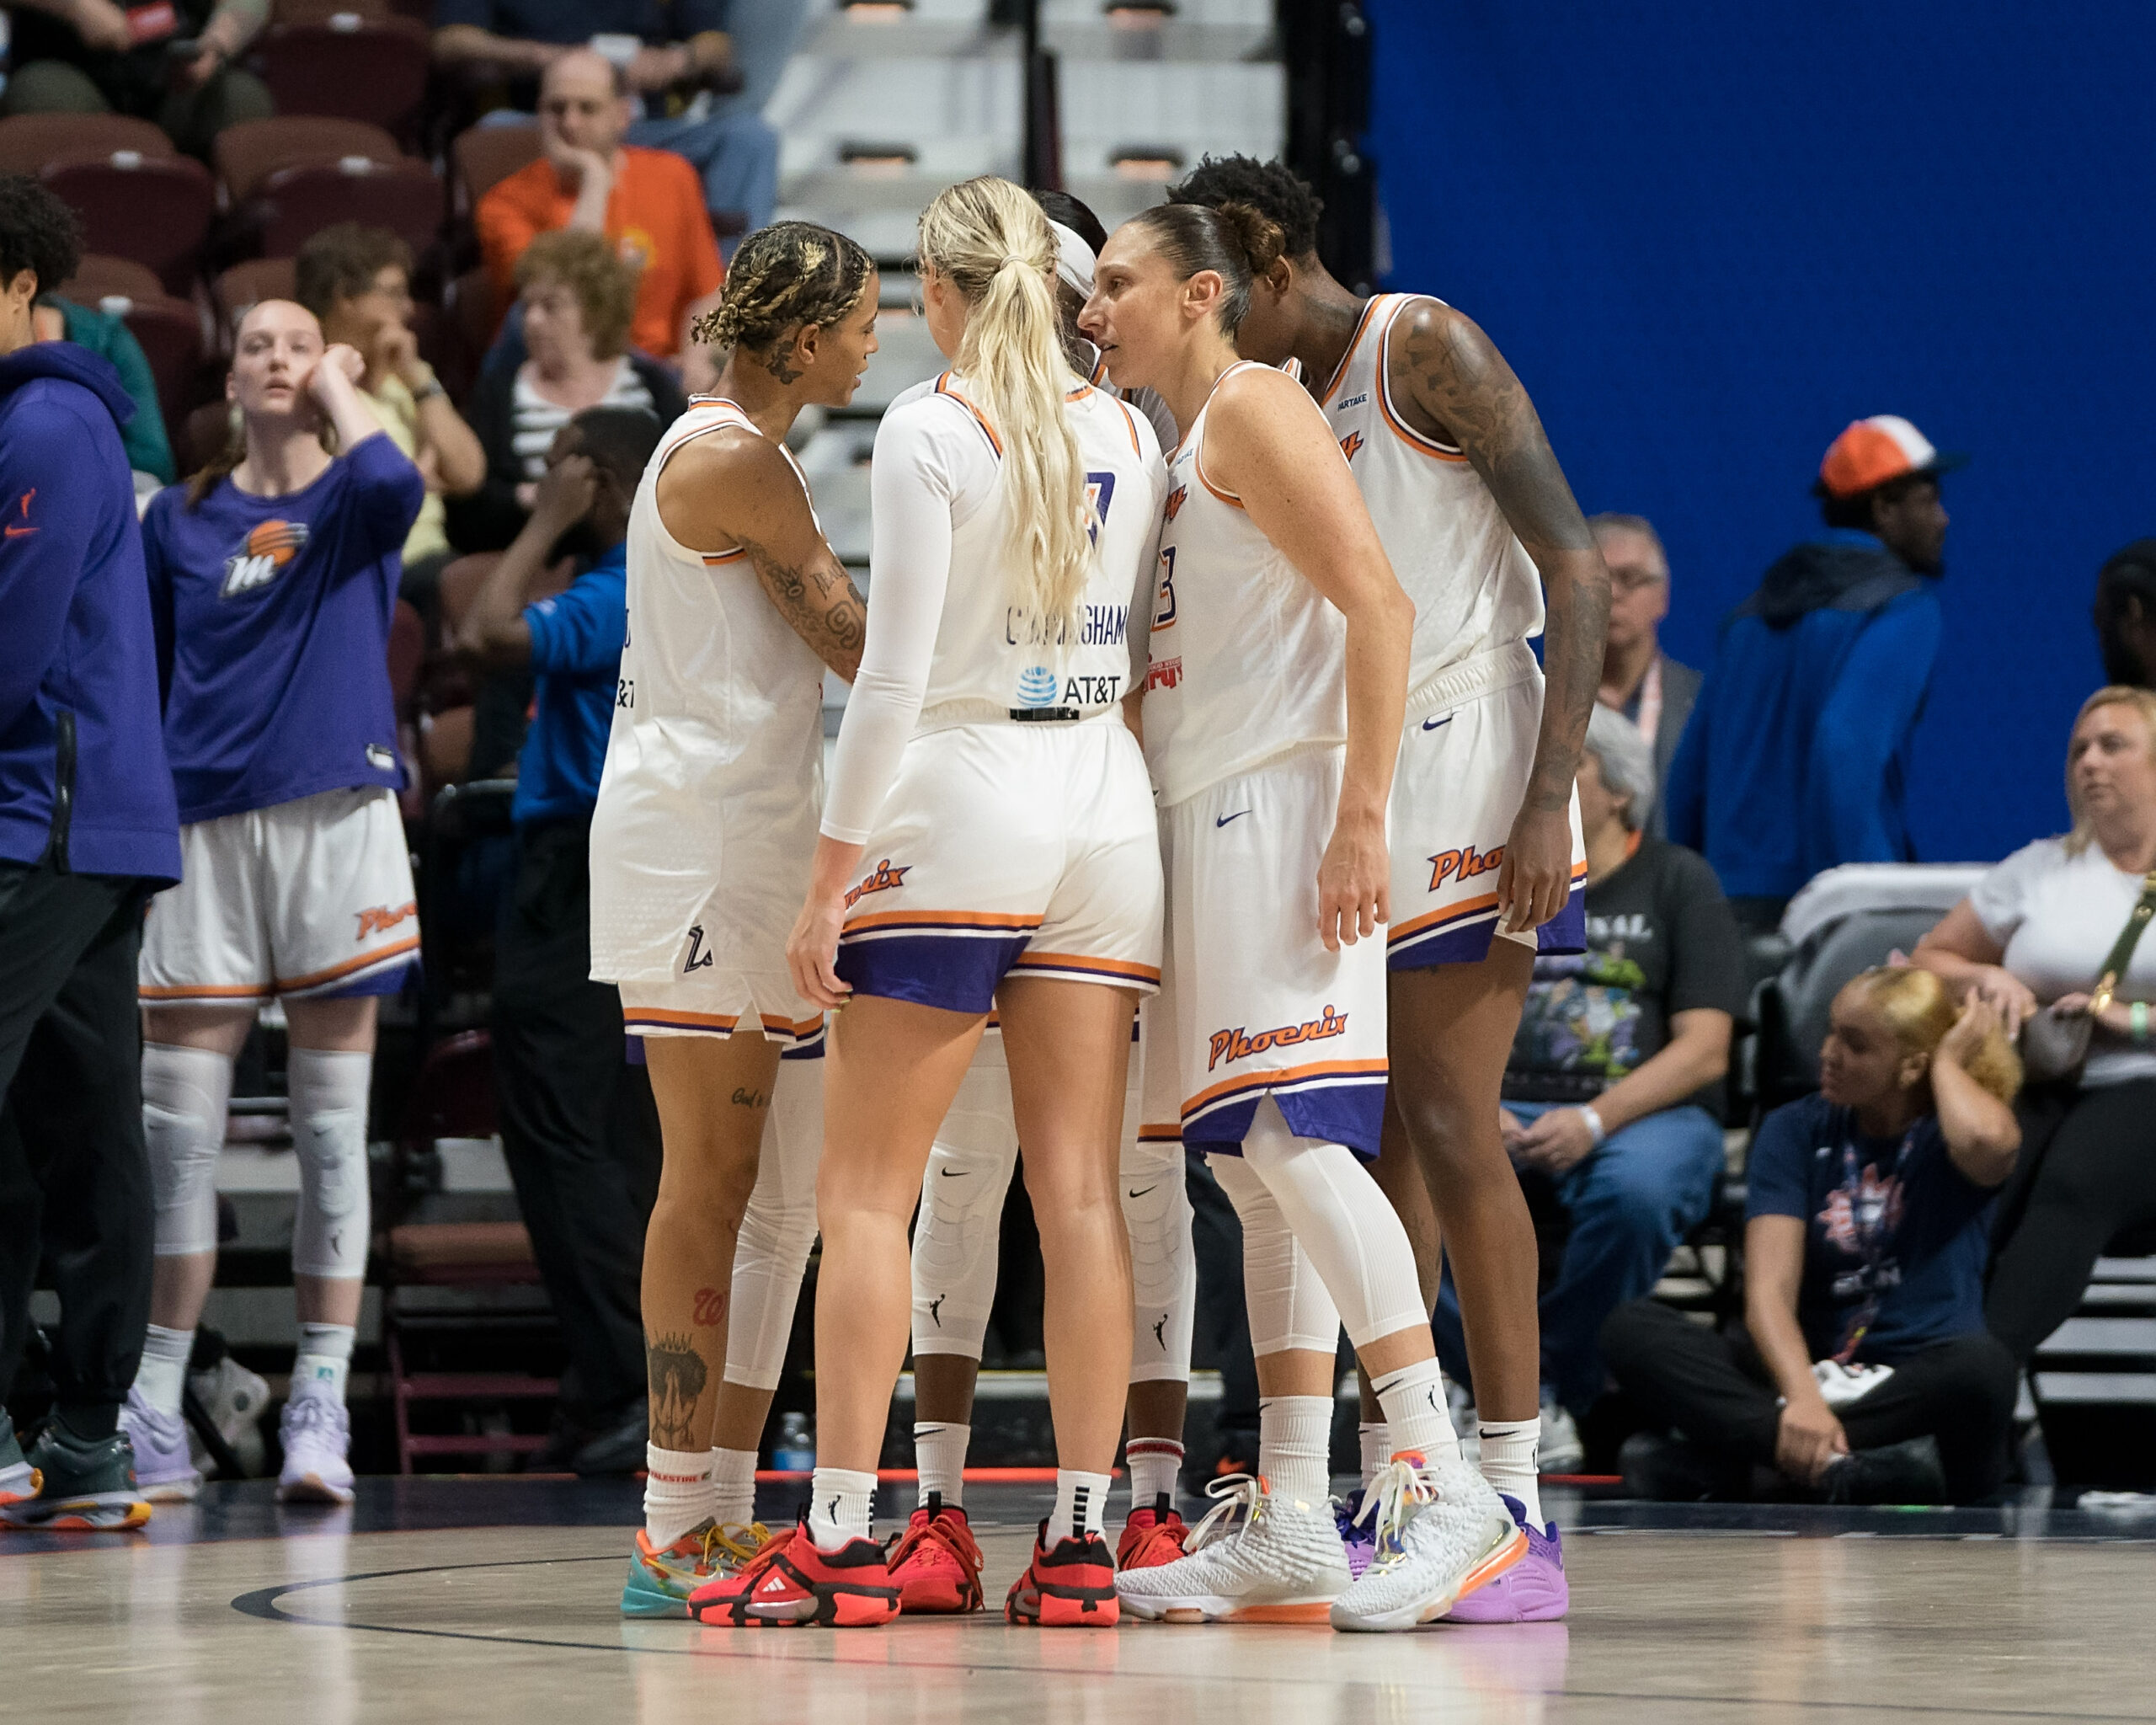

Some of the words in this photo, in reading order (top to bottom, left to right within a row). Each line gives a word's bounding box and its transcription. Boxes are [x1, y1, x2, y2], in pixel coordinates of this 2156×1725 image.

[1337, 393, 1367, 411] PARTAKE
[1063, 676, 1121, 704] AT&T
[1209, 1005, 1348, 1072] Phoenix
